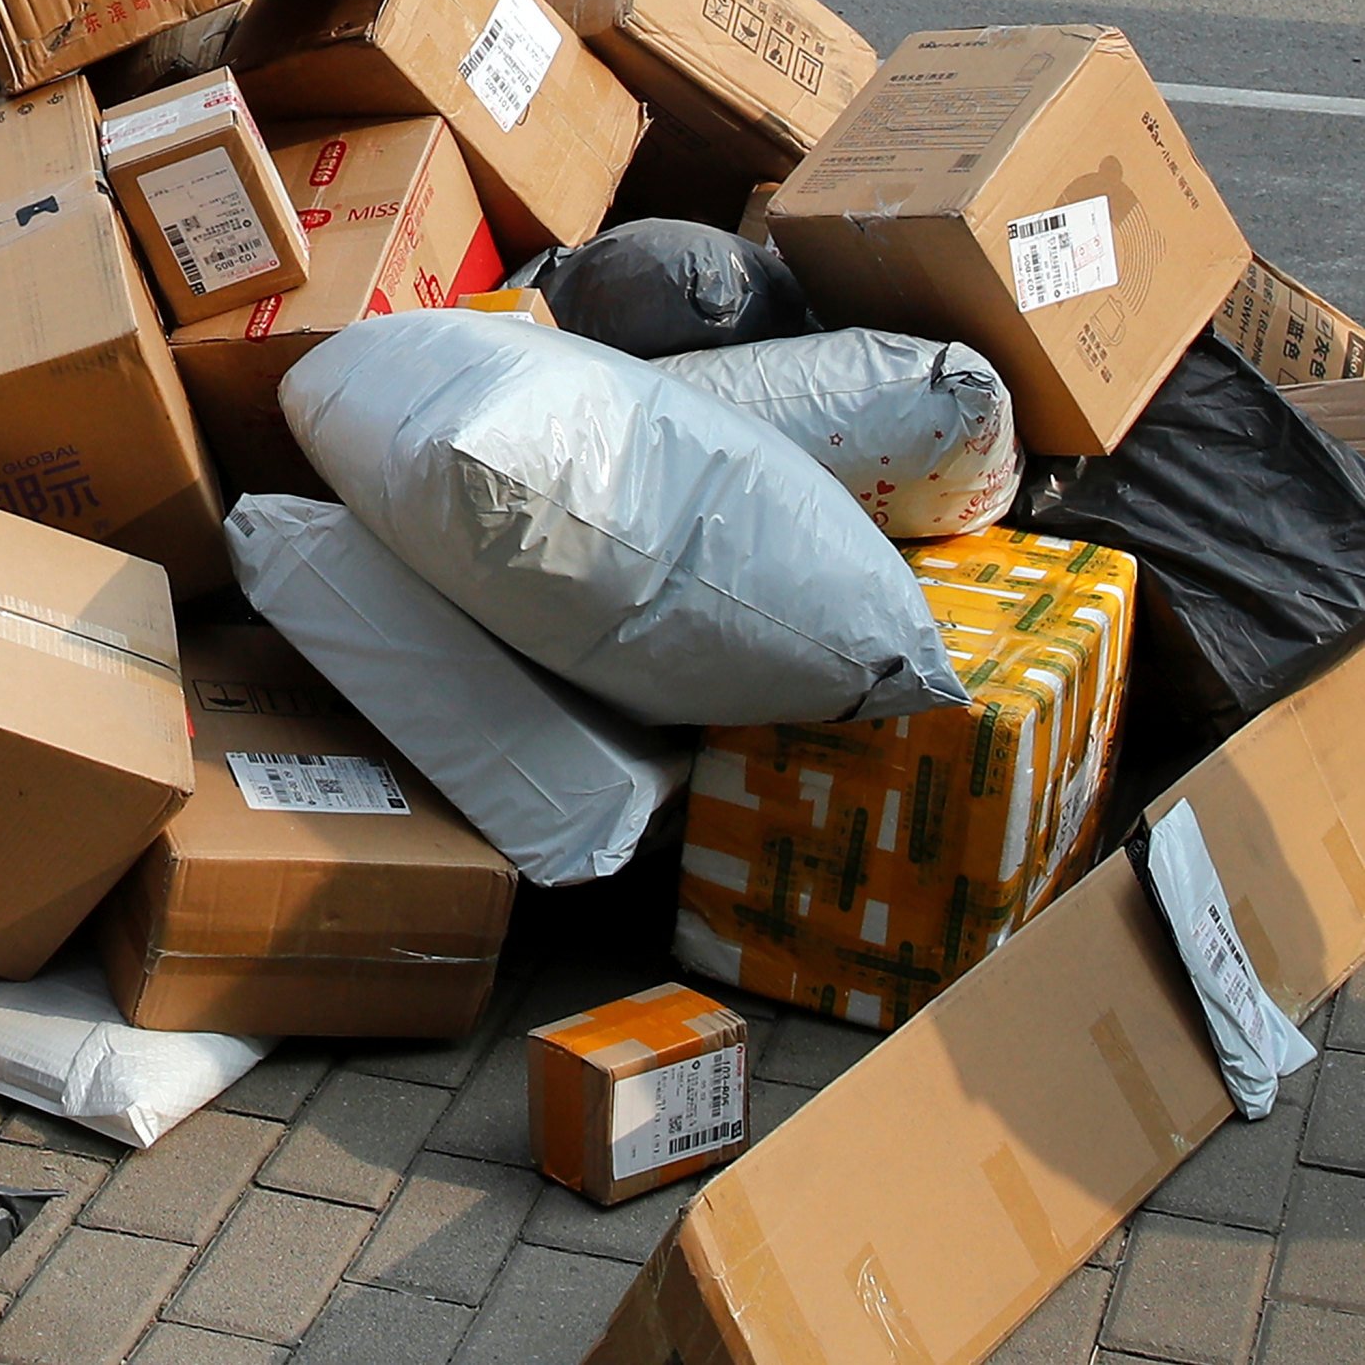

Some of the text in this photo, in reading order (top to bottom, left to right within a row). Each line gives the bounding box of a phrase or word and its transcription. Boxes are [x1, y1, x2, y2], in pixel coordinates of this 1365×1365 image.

[347, 201, 400, 222] MISS
[1282, 315, 1305, 361] 蓝色
[1310, 336, 1332, 378] 灰色
[1, 444, 80, 476] GLOBAL
